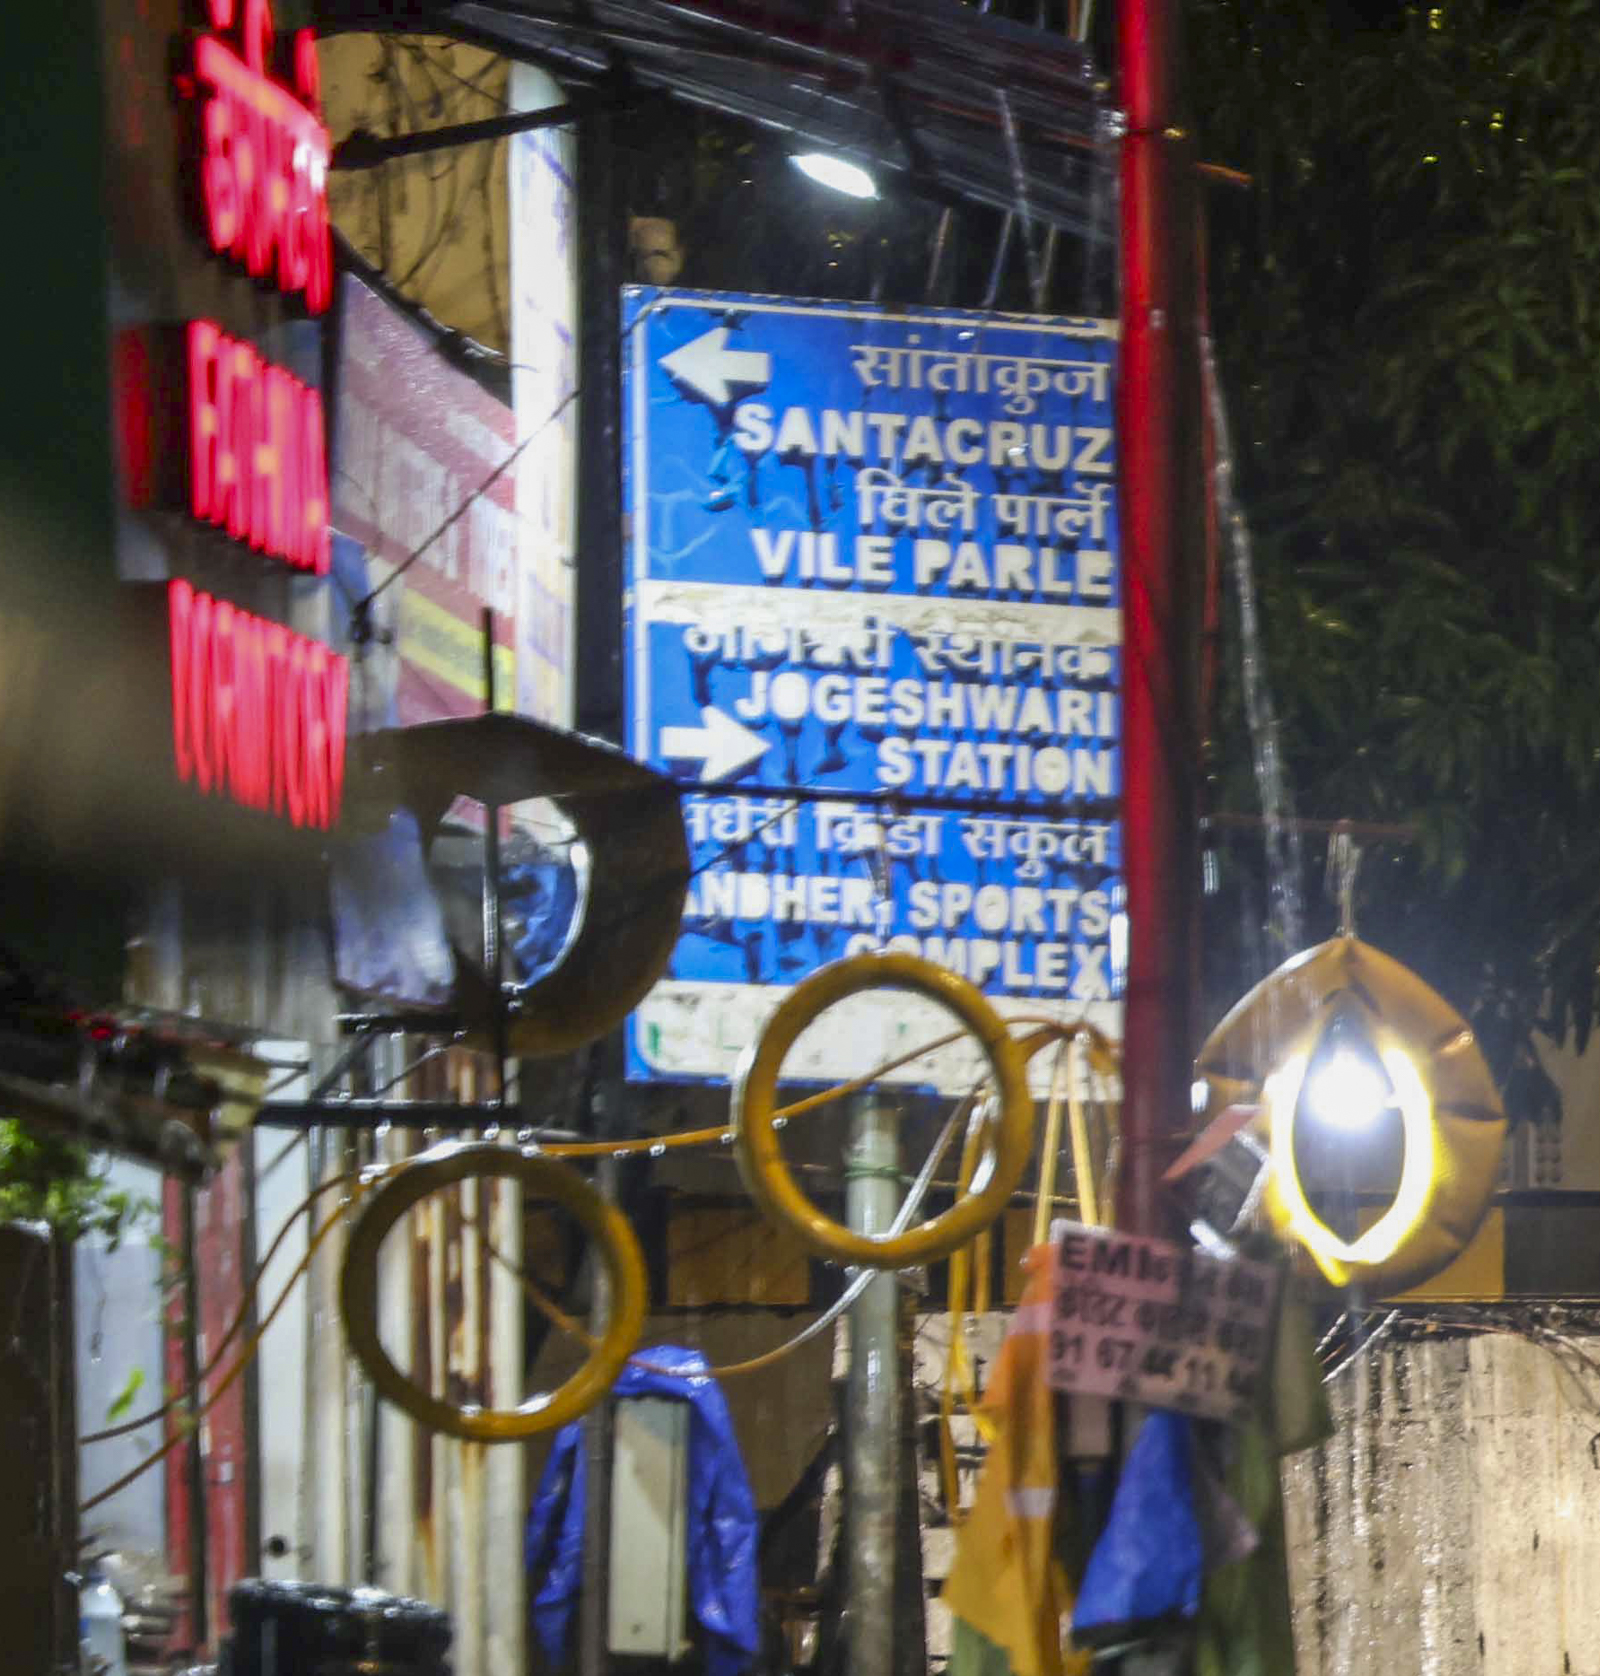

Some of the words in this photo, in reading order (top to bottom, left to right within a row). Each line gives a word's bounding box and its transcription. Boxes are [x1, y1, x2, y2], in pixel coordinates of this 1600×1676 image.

[733, 404, 1114, 473] SANTACRUZ
[856, 467, 981, 532] विले
[990, 481, 1113, 540] पार्ले
[750, 528, 896, 584] VILE
[913, 538, 1115, 597] PARLE
[735, 671, 1114, 737] JOGESHWARI
[876, 736, 1112, 796] STATION
[682, 868, 890, 928] NDHER
[908, 880, 1109, 936] SPORTS
